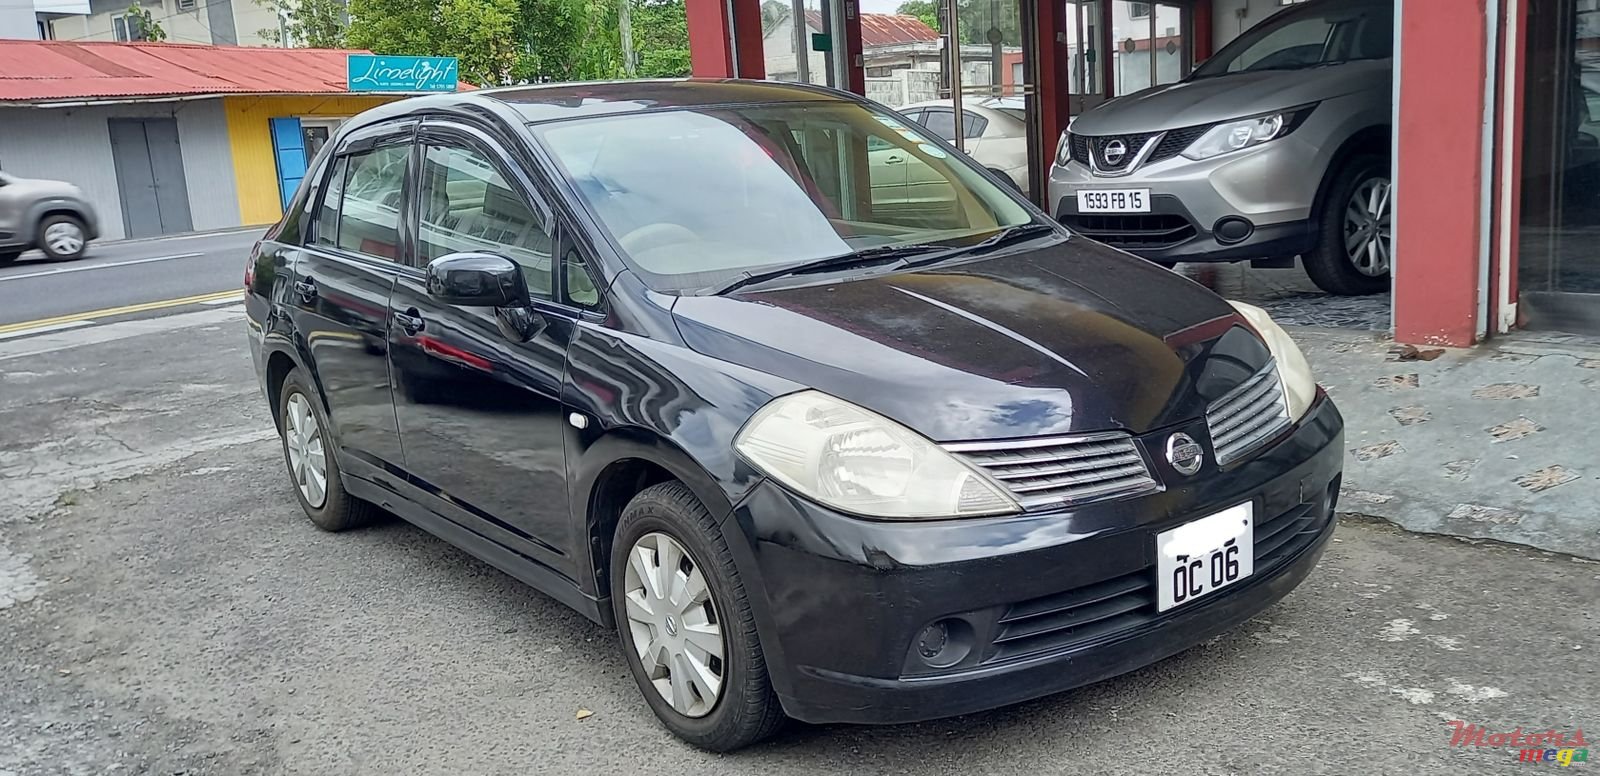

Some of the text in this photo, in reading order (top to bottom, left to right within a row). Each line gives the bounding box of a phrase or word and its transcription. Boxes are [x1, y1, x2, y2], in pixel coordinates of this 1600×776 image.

[352, 58, 455, 89] Limelight
[1084, 192, 1141, 209] 1593 FB 15
[1211, 545, 1239, 588] 06
